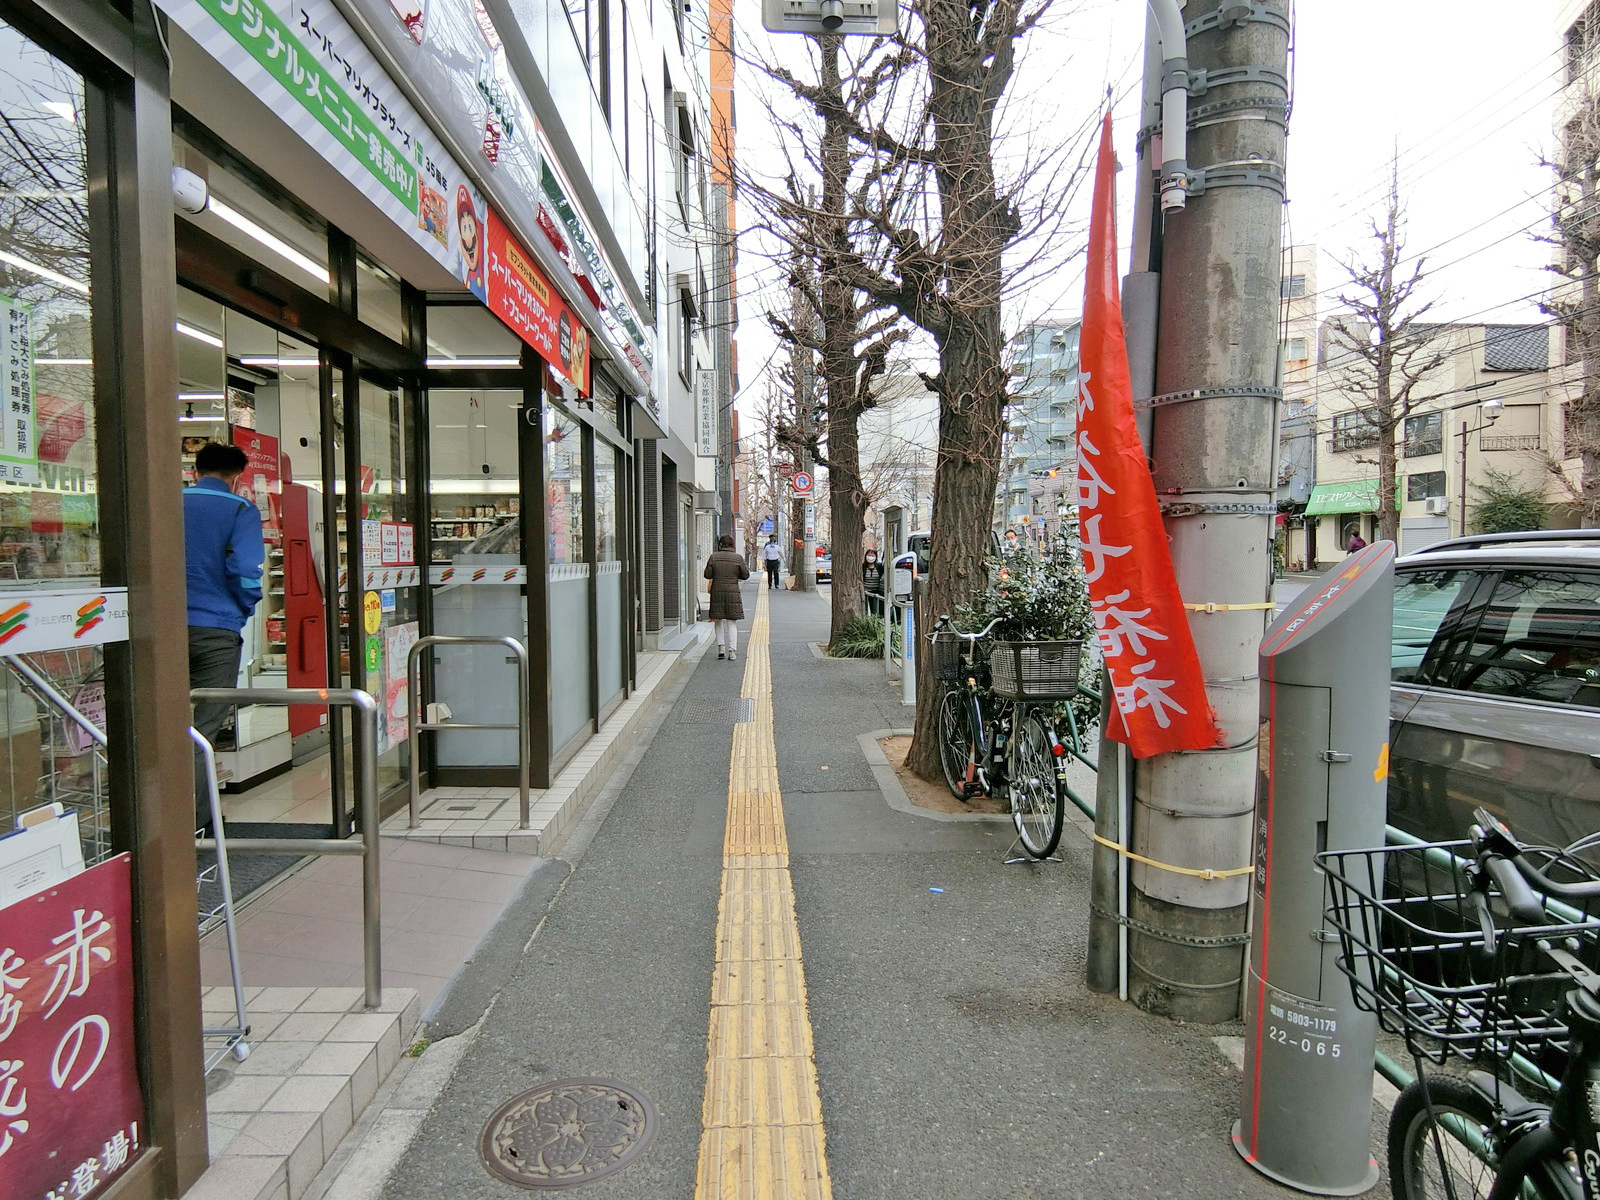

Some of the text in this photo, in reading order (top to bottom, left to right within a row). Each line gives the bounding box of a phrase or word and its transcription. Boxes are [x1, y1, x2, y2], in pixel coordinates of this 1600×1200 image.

[425, 156, 448, 192] 35周年
[491, 251, 558, 336] スーパーマリオ3Dワールド
[17, 418, 27, 453] 取扱所
[1285, 584, 1340, 632] 文京区
[1258, 817, 1268, 885] 消火器
[41, 908, 112, 1092] 赤の
[1287, 1010, 1337, 1032] 5803-1179
